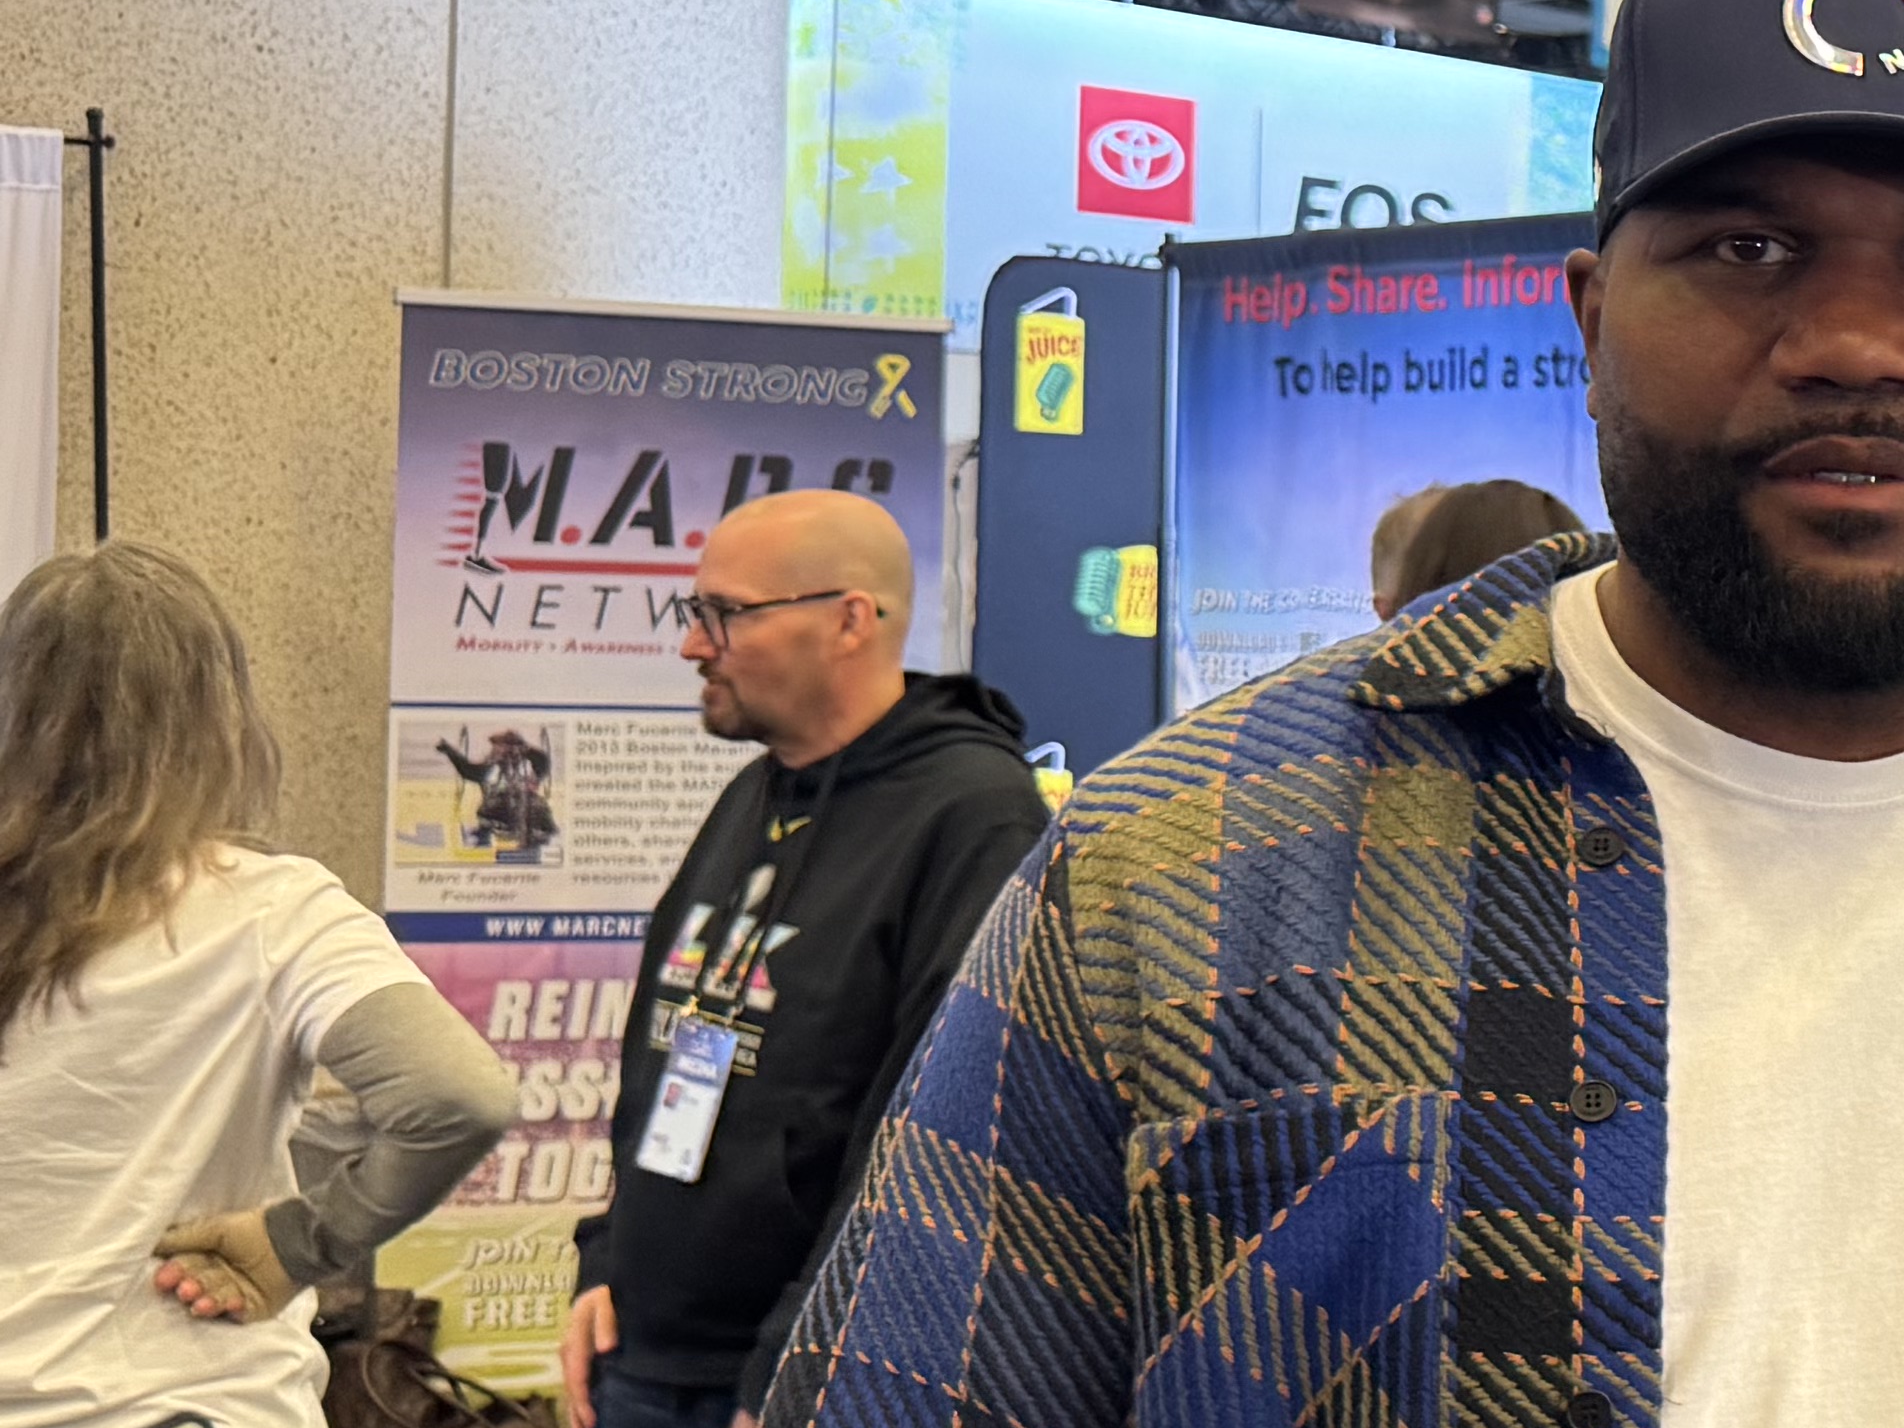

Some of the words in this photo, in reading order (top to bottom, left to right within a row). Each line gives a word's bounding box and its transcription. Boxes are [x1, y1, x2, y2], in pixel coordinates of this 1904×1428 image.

[1222, 273, 1319, 330] Help.
[1326, 264, 1448, 315] Share.
[1462, 254, 1573, 309] Infor
[428, 348, 651, 396] BOSTON
[661, 358, 871, 406] STRONG
[1273, 355, 1314, 400] To
[1320, 346, 1392, 403] help
[1403, 344, 1490, 393] build
[1501, 356, 1520, 389] a
